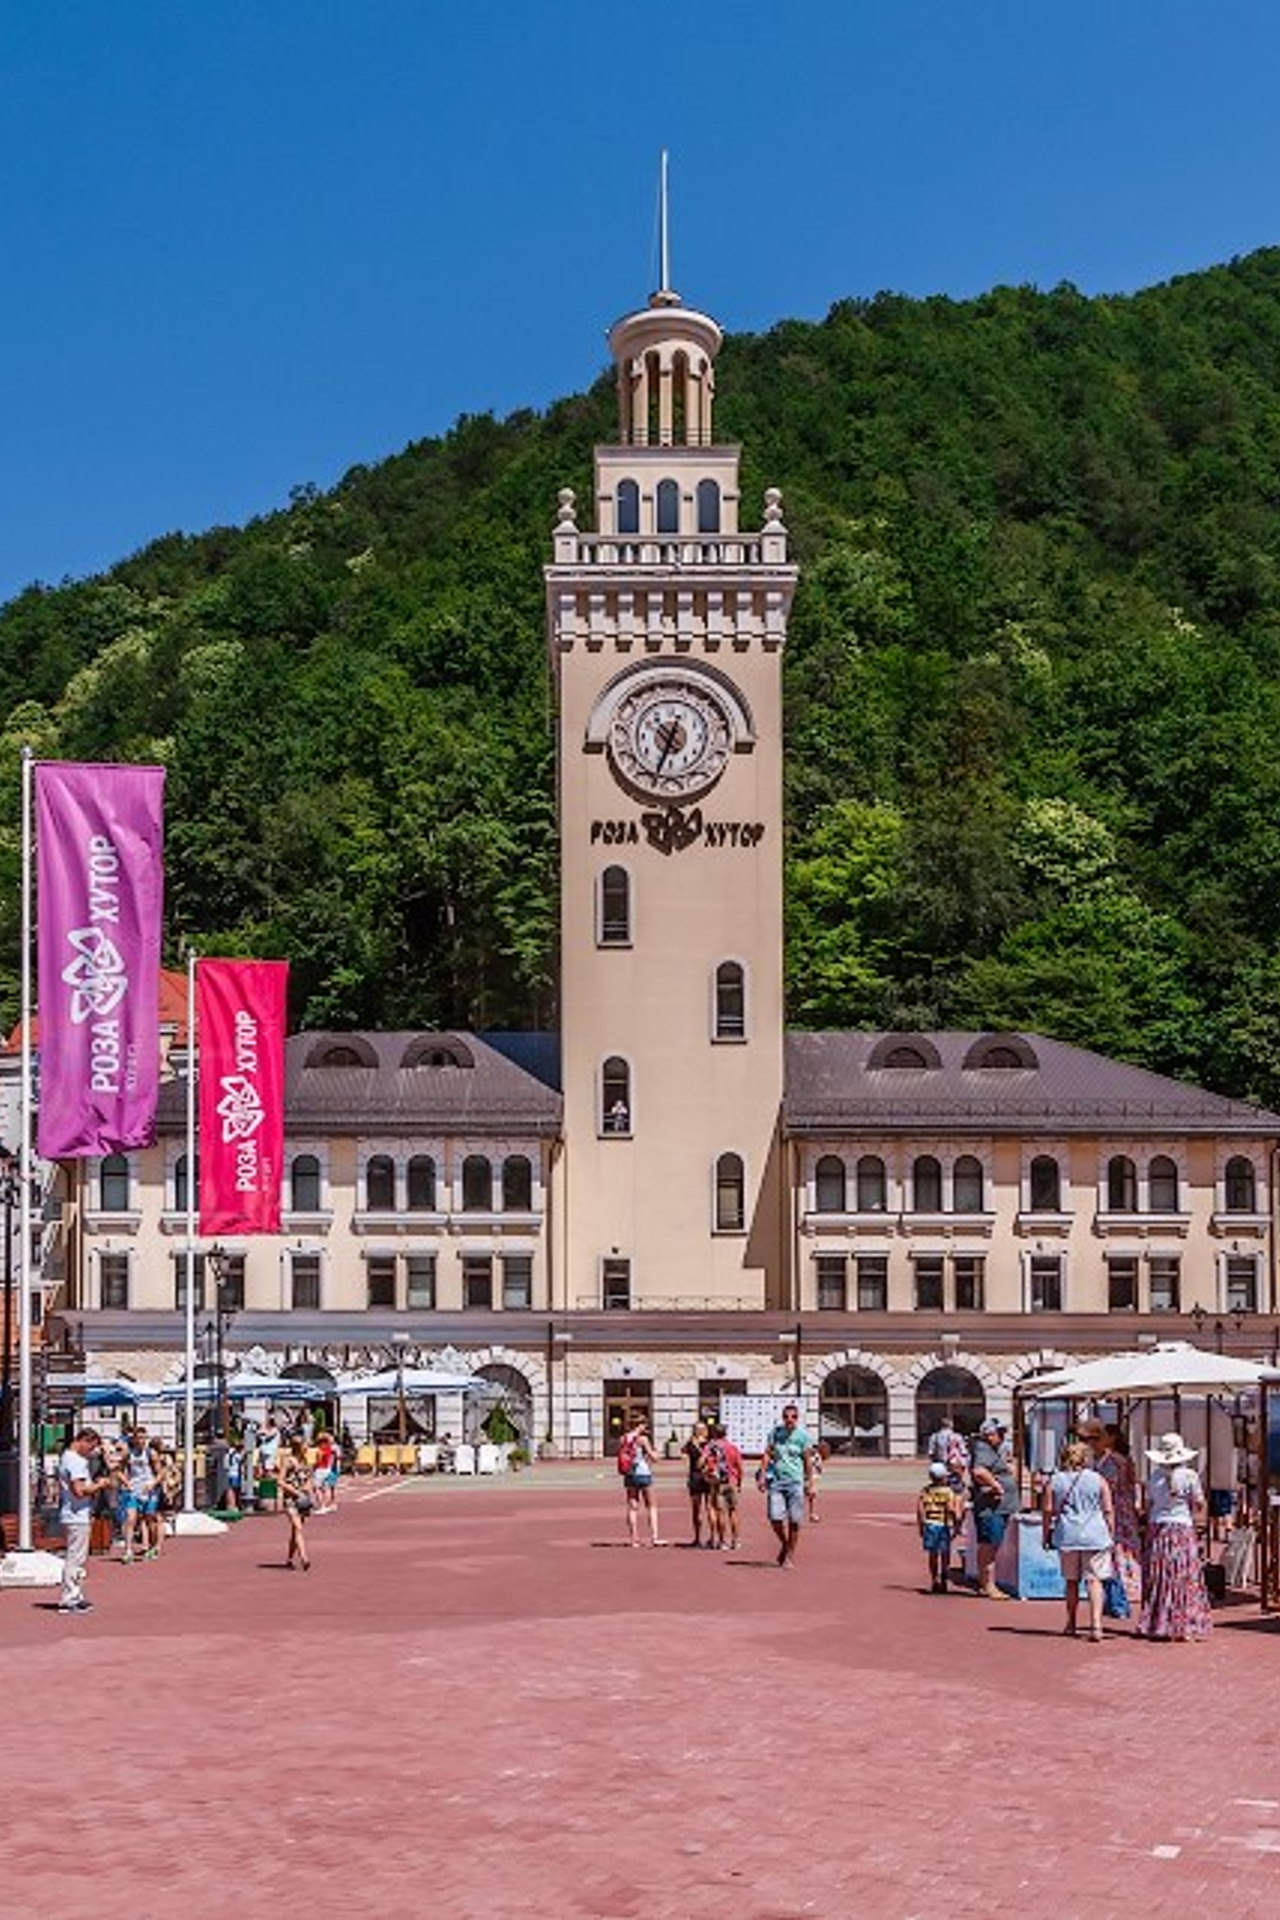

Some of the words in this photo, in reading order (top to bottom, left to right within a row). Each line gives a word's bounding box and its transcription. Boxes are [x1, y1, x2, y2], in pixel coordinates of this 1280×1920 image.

[590, 820, 639, 845] РОЗА
[704, 822, 765, 848] ХУТОР
[89, 834, 120, 923] ХУТОР
[91, 1020, 120, 1093] РОЗА
[234, 1010, 257, 1074] ХУТОР
[234, 1139, 257, 1191] РОЗА
